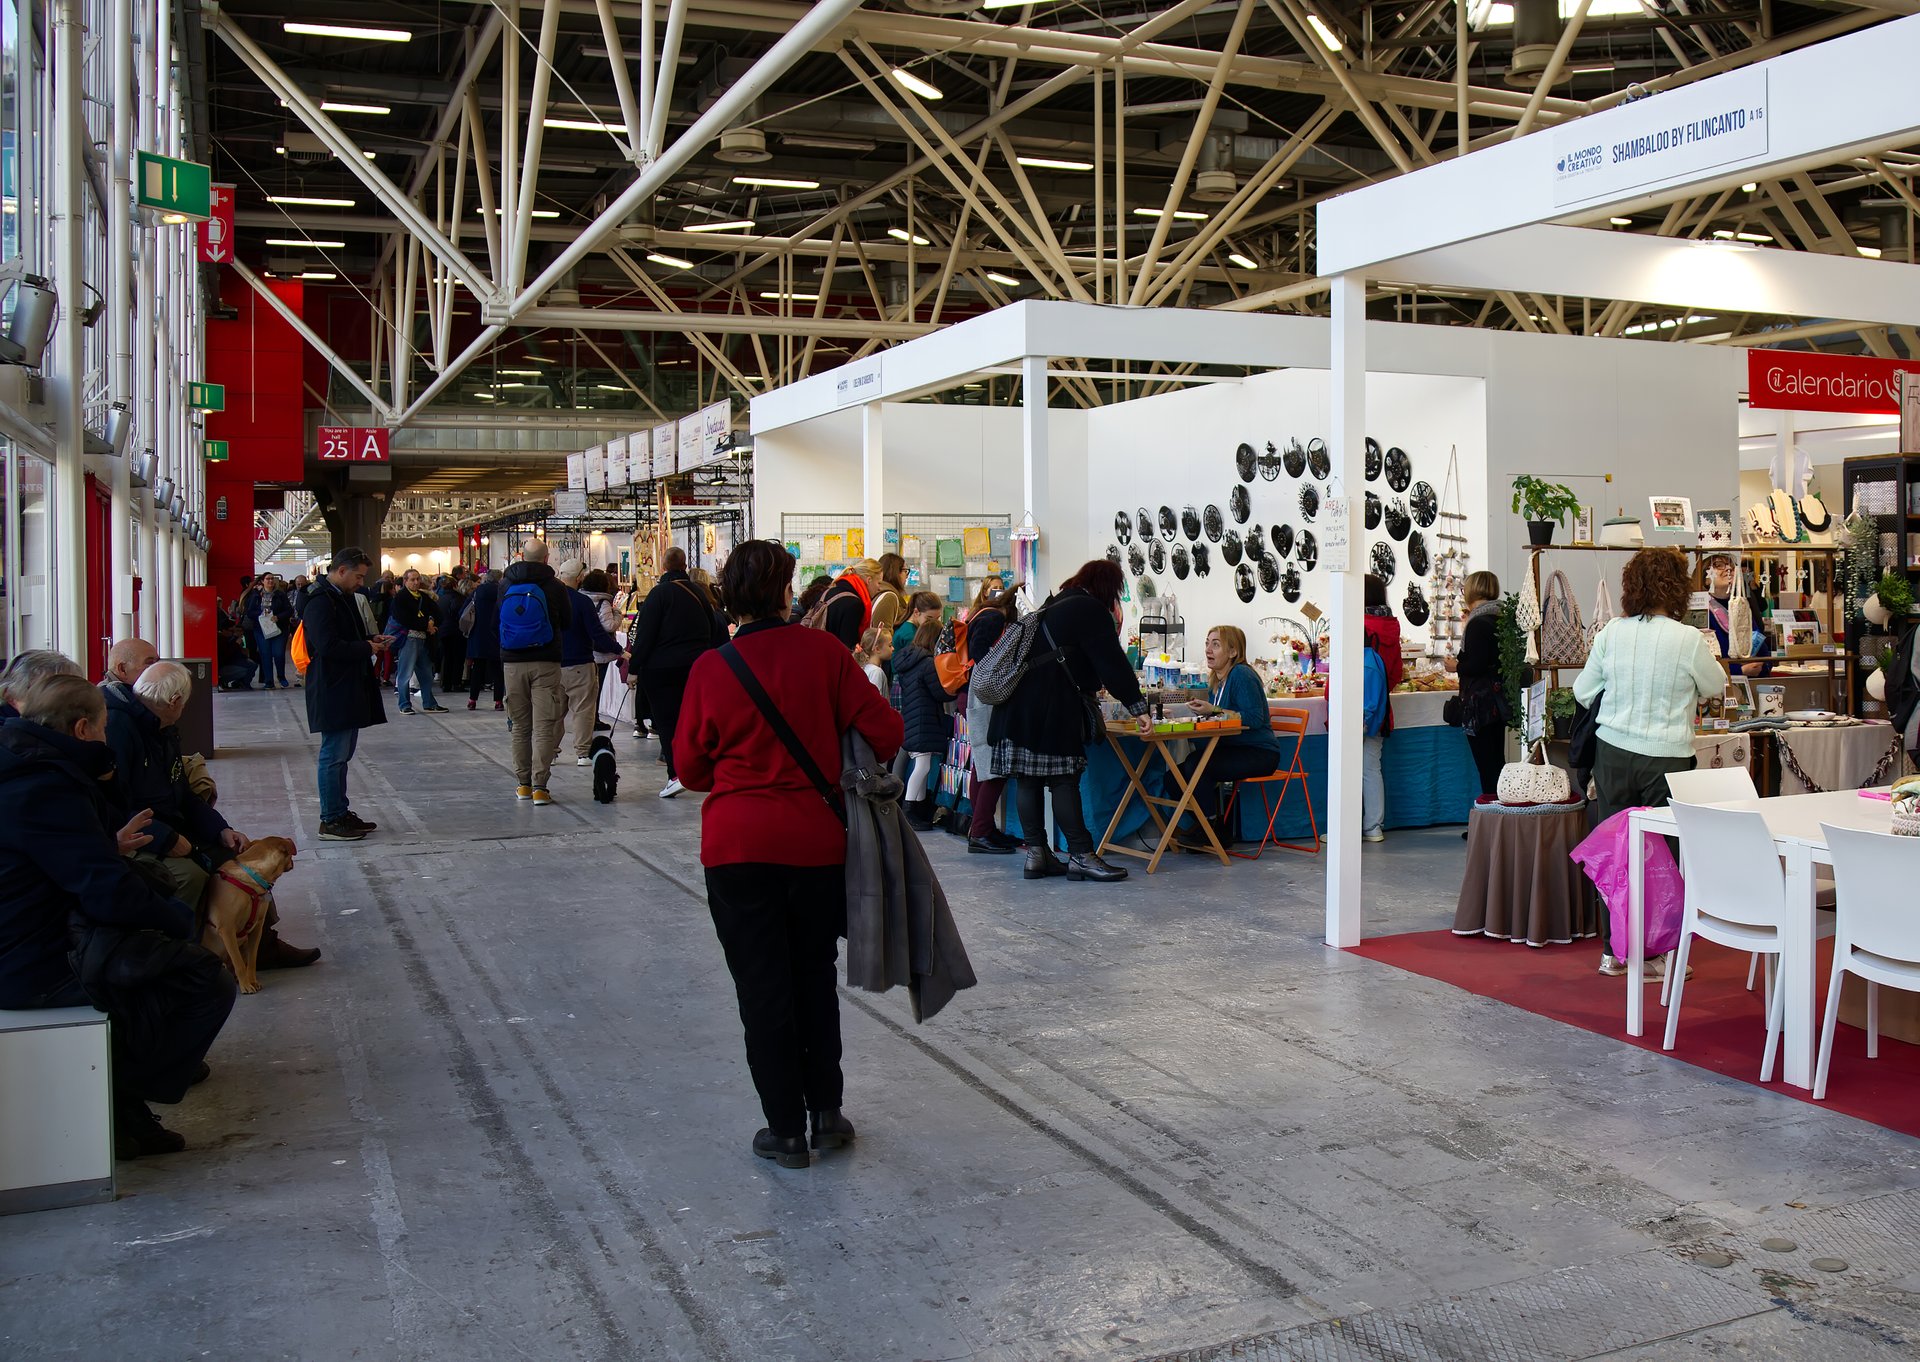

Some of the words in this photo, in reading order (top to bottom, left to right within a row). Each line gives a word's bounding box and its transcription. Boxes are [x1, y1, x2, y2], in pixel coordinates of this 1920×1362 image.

[1612, 130, 1669, 163] SHAMBALOO
[1671, 125, 1684, 147] BY
[1686, 108, 1745, 143] FILINCANTO
[1749, 110, 1754, 121] A
[1755, 107, 1763, 119] 15
[1567, 153, 1573, 163] IL
[1574, 145, 1602, 161] MONDO
[1567, 155, 1602, 172] CREATIVO
[1767, 367, 1883, 399] Calendario
[323, 440, 348, 458] 25
[361, 435, 381, 458] A
[258, 529, 266, 539] A
